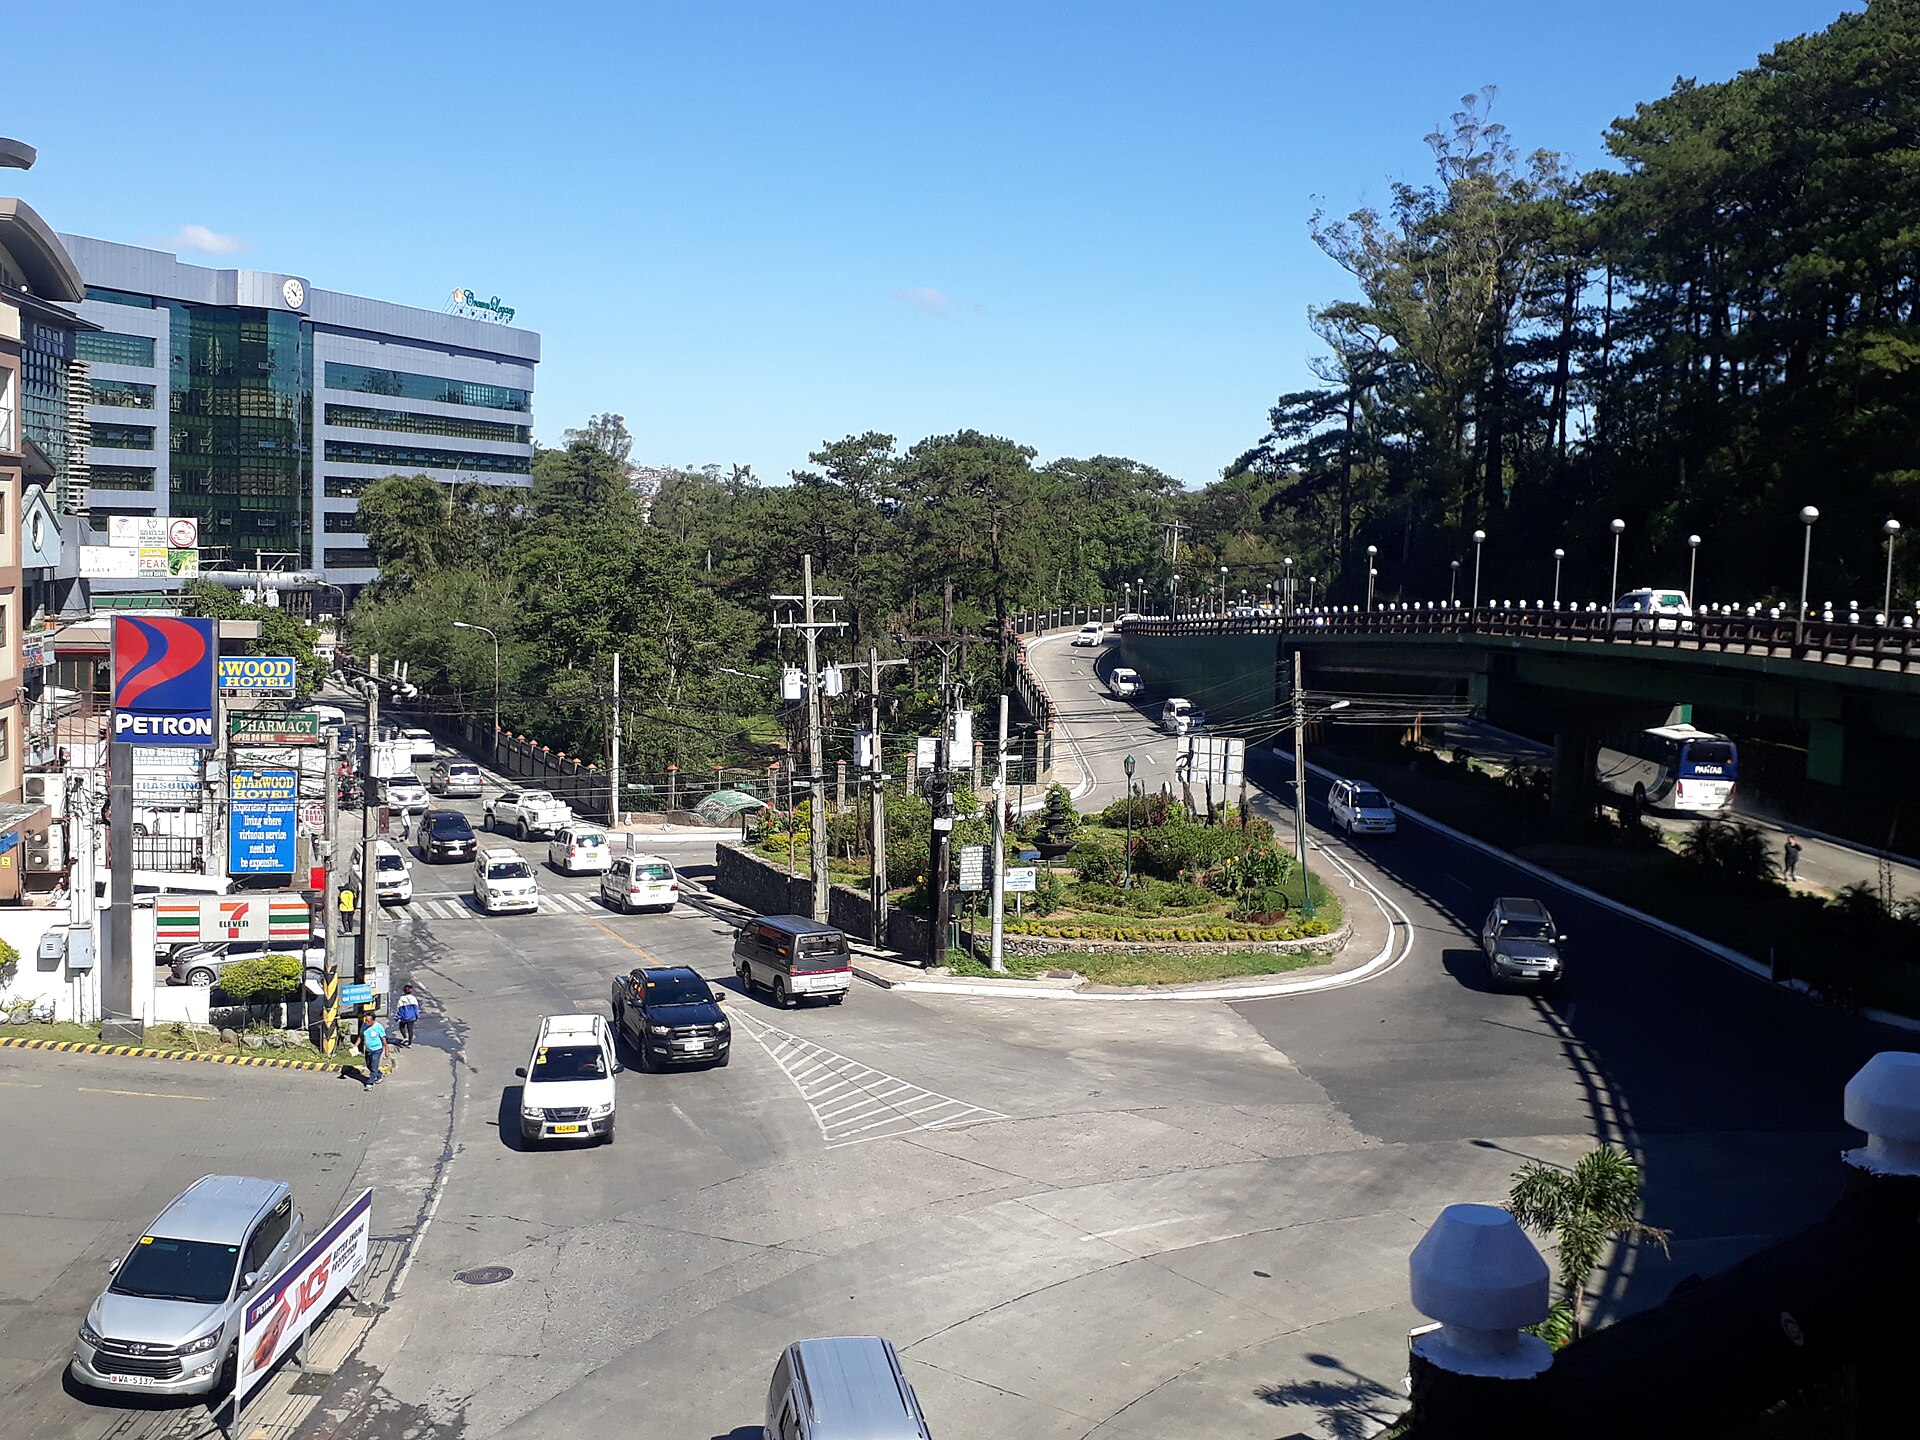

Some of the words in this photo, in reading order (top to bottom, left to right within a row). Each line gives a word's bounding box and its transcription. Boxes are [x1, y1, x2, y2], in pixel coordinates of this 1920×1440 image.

[139, 559, 167, 568] PEAK
[225, 677, 291, 687] HOTEL
[115, 713, 212, 735] PETRON
[239, 722, 313, 733] PHARMACY
[233, 734, 250, 742] OPEN
[251, 734, 259, 742] 24
[260, 734, 275, 742] HRS
[232, 774, 294, 789] STARWOOD
[233, 790, 294, 799] HOTEL
[233, 801, 266, 814] Experience
[244, 815, 262, 828] living
[263, 815, 282, 826] where
[239, 830, 264, 840] virtuous
[265, 829, 287, 840] service
[249, 843, 264, 854] need
[265, 843, 276, 854] not
[240, 857, 249, 868] be
[219, 902, 249, 939] 7
[256, 1293, 277, 1317] PETRON
